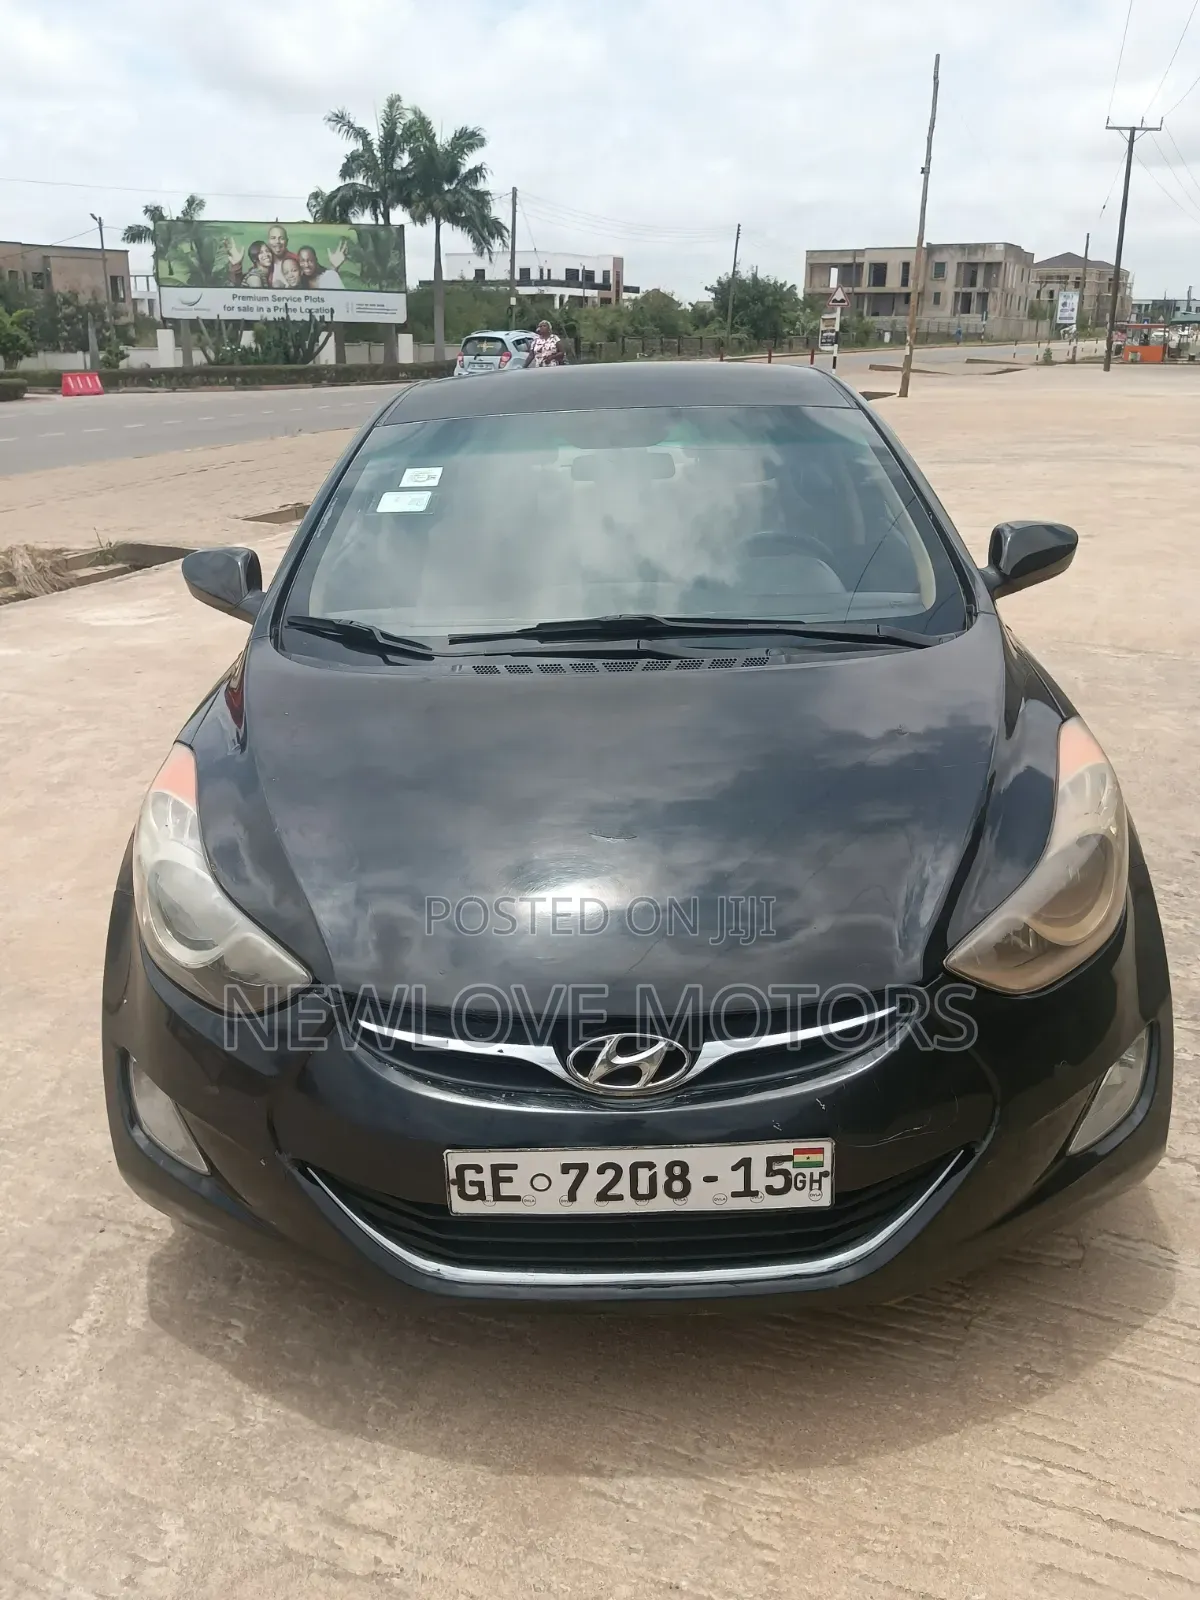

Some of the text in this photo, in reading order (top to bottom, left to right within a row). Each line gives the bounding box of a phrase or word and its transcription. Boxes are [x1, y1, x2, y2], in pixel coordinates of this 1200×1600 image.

[232, 293, 325, 304] Premium Service Plots
[223, 304, 235, 312] for
[237, 305, 254, 313] sale
[256, 305, 264, 313] in
[299, 305, 335, 314] Locatio
[454, 1163, 522, 1201] GE
[793, 1171, 823, 1192] GH
